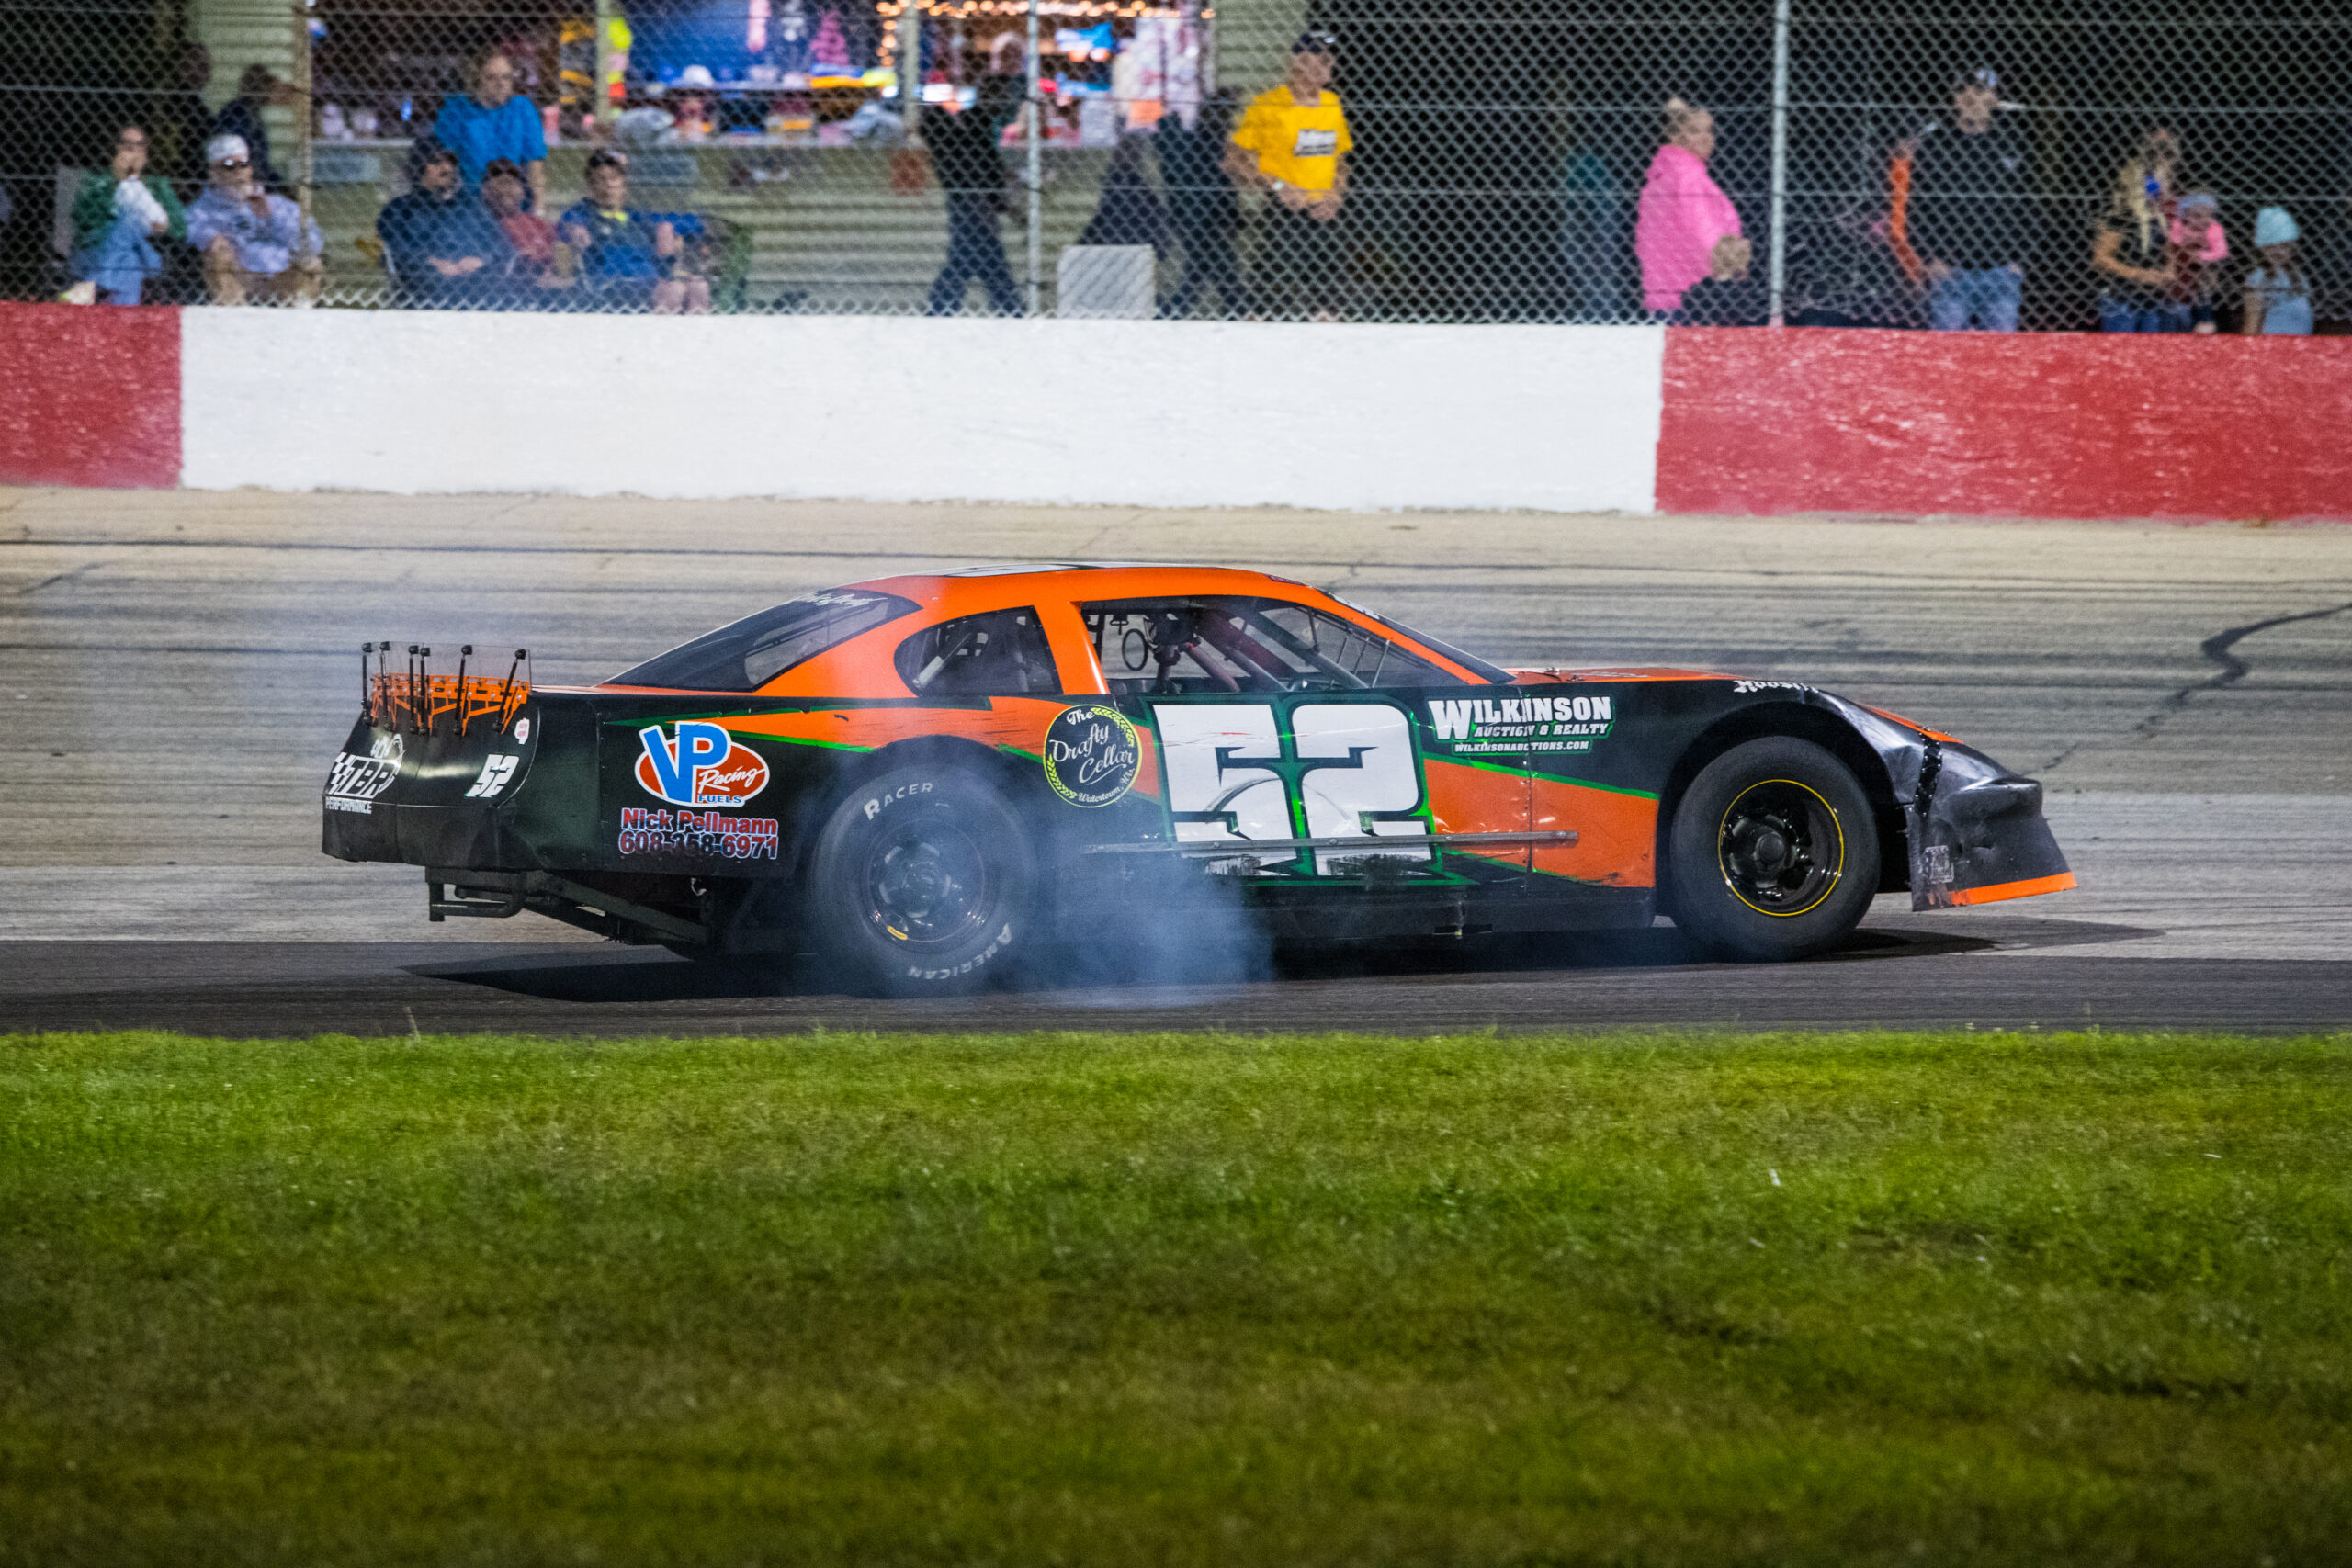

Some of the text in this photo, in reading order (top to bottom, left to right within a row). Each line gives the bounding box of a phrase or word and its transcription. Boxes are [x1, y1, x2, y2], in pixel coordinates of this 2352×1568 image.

[1066, 709, 1095, 725] The
[1428, 697, 1612, 740] WILKINSON
[1474, 722, 1610, 738] AUCTION & REALTY
[1049, 723, 1109, 763] Drafty
[1454, 740, 1589, 753] WILKINSONAUCTIONS.COM
[466, 753, 520, 798] 52
[639, 721, 731, 806] VP
[698, 766, 766, 795] Racing
[1079, 744, 1135, 784] Cellar
[325, 796, 372, 815] PERFORMANCE
[698, 795, 742, 804] FUELS
[864, 782, 933, 821] RACER
[1152, 704, 1435, 877] 52
[621, 807, 779, 837] Nick Pellmann
